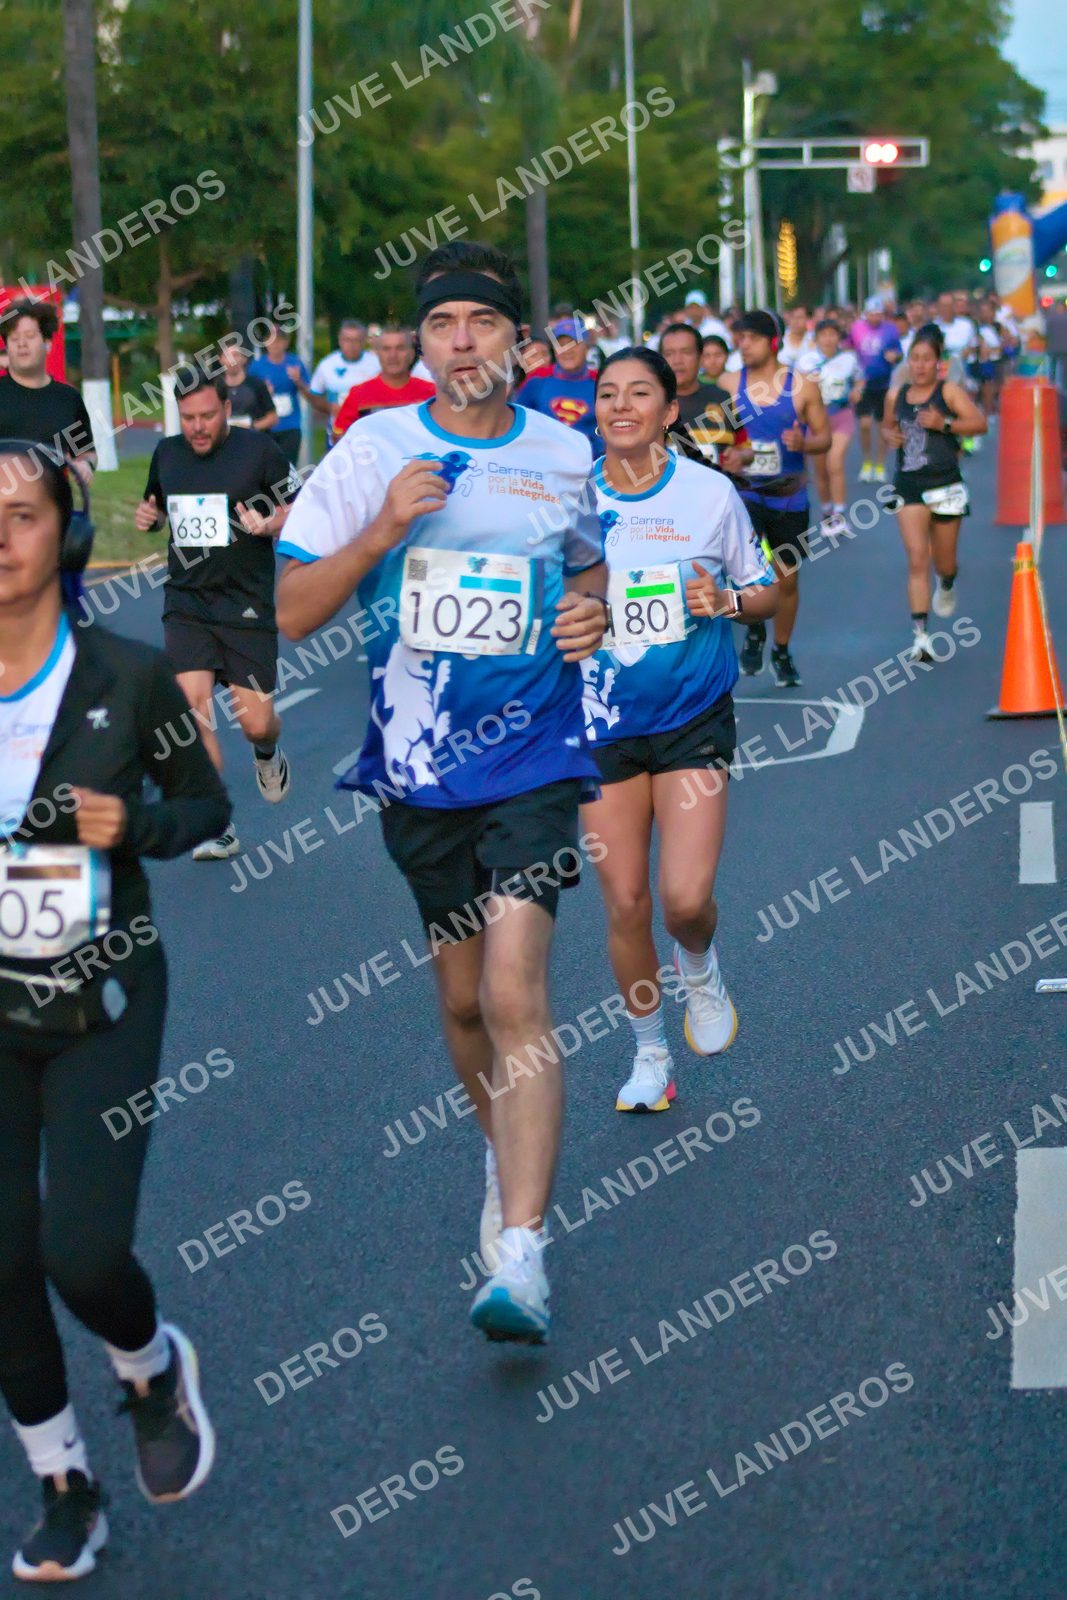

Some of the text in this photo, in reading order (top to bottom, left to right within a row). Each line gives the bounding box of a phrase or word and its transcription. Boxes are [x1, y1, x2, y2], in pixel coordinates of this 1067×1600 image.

[488, 462, 543, 480] Carrera
[488, 476, 506, 485] por
[520, 479, 545, 491] Vida
[177, 516, 217, 540] 633
[631, 516, 674, 525] Carrera
[630, 526, 643, 534] por
[645, 533, 691, 543] Integridad
[410, 591, 522, 643] 1023
